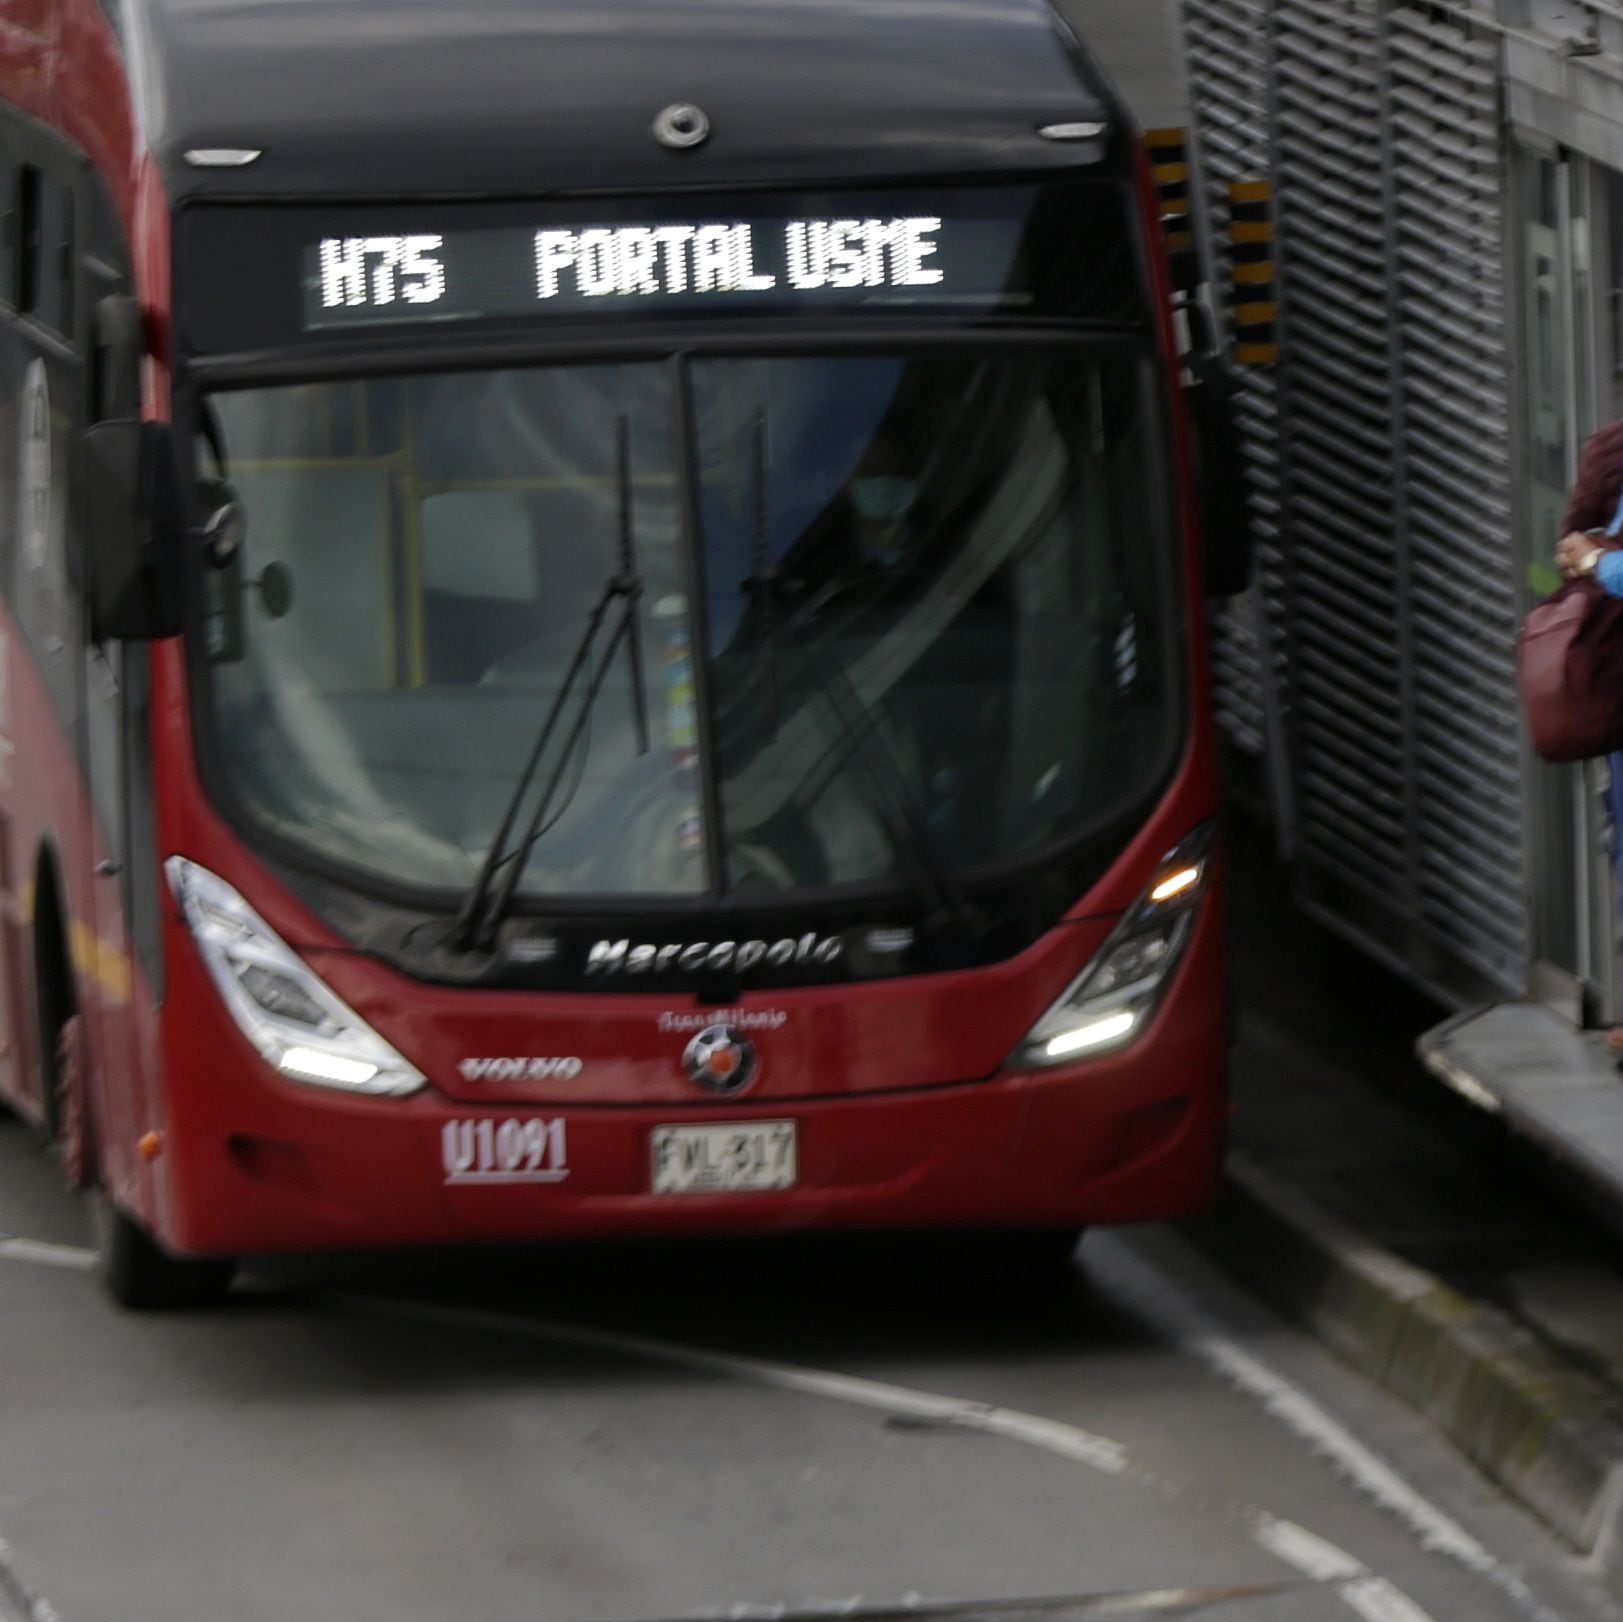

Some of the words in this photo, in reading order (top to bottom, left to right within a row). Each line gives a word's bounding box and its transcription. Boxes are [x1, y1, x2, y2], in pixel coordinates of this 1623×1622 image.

[320, 234, 446, 307] H75
[534, 223, 776, 299] PORTAL
[785, 217, 943, 289] USME
[458, 1056, 584, 1081] VOLVO
[441, 1117, 567, 1172] U1091
